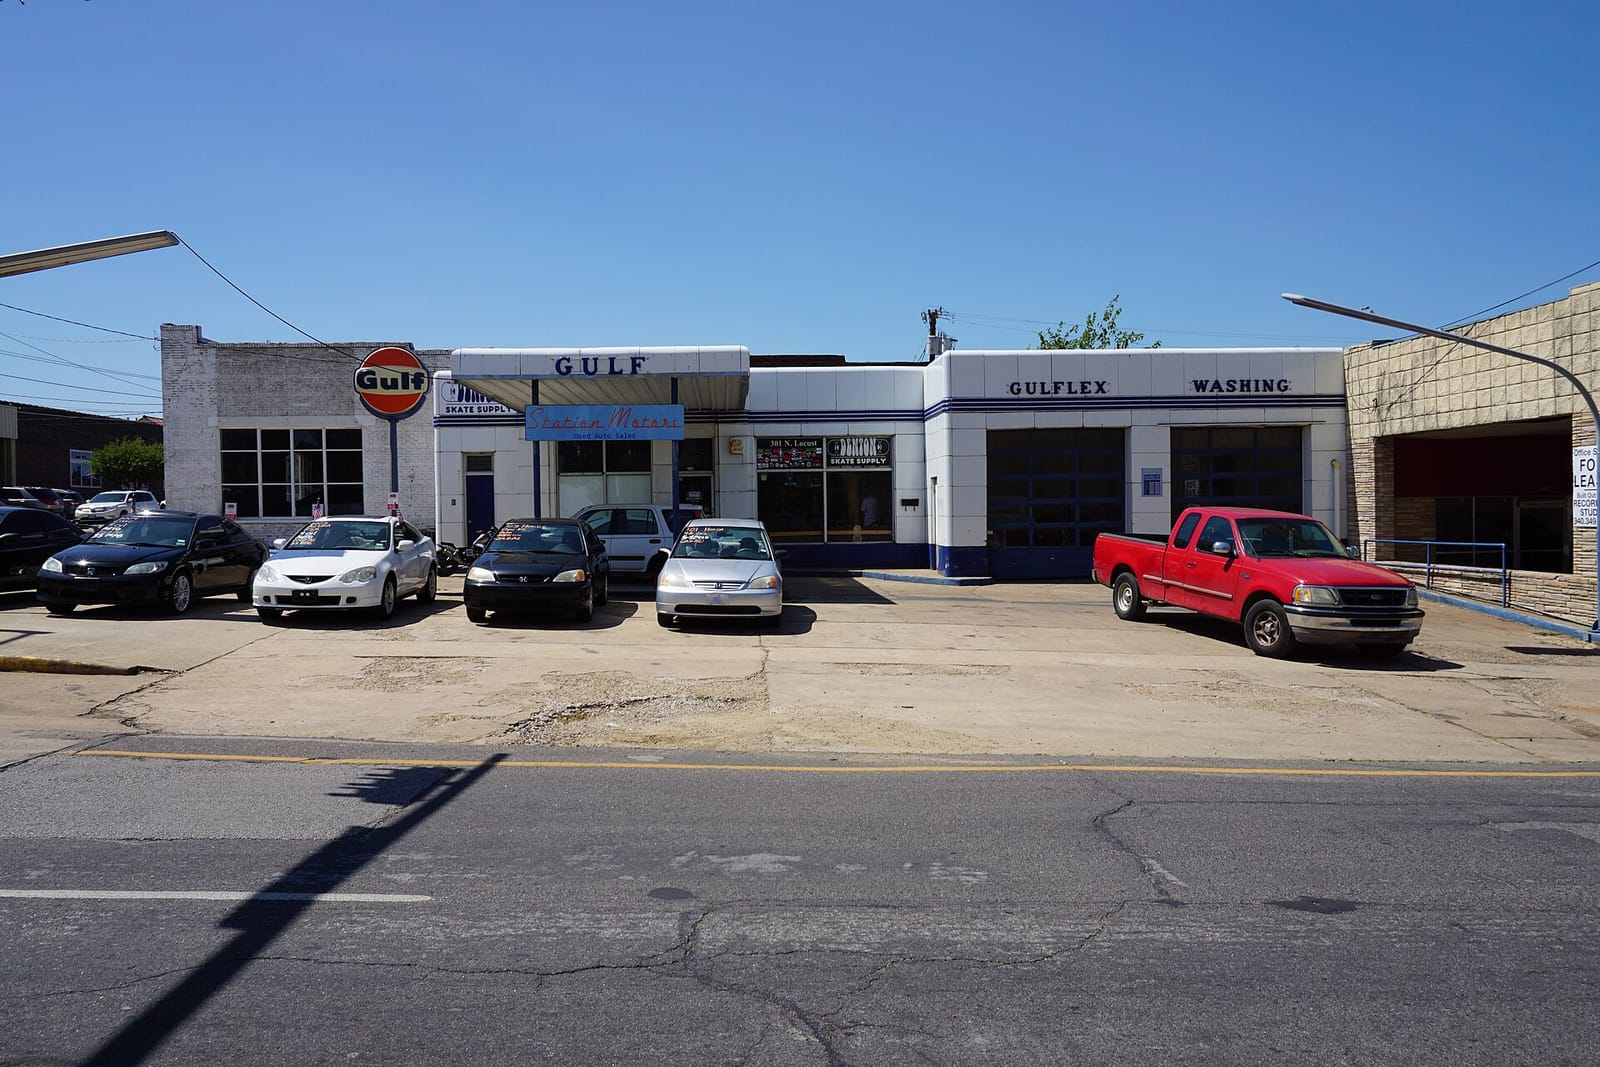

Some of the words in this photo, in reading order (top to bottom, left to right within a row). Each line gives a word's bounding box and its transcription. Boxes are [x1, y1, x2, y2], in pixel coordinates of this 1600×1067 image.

[555, 356, 646, 376] GULF
[356, 368, 425, 391] Gulf
[1192, 379, 1290, 393] WASHING
[1009, 381, 1108, 395] GULFLEX
[527, 407, 605, 429] Station
[608, 407, 682, 429] Motors
[840, 437, 877, 456] DENTON
[1580, 458, 1596, 471] FO
[1574, 475, 1596, 488] LEA
[1574, 500, 1598, 508] RECOR
